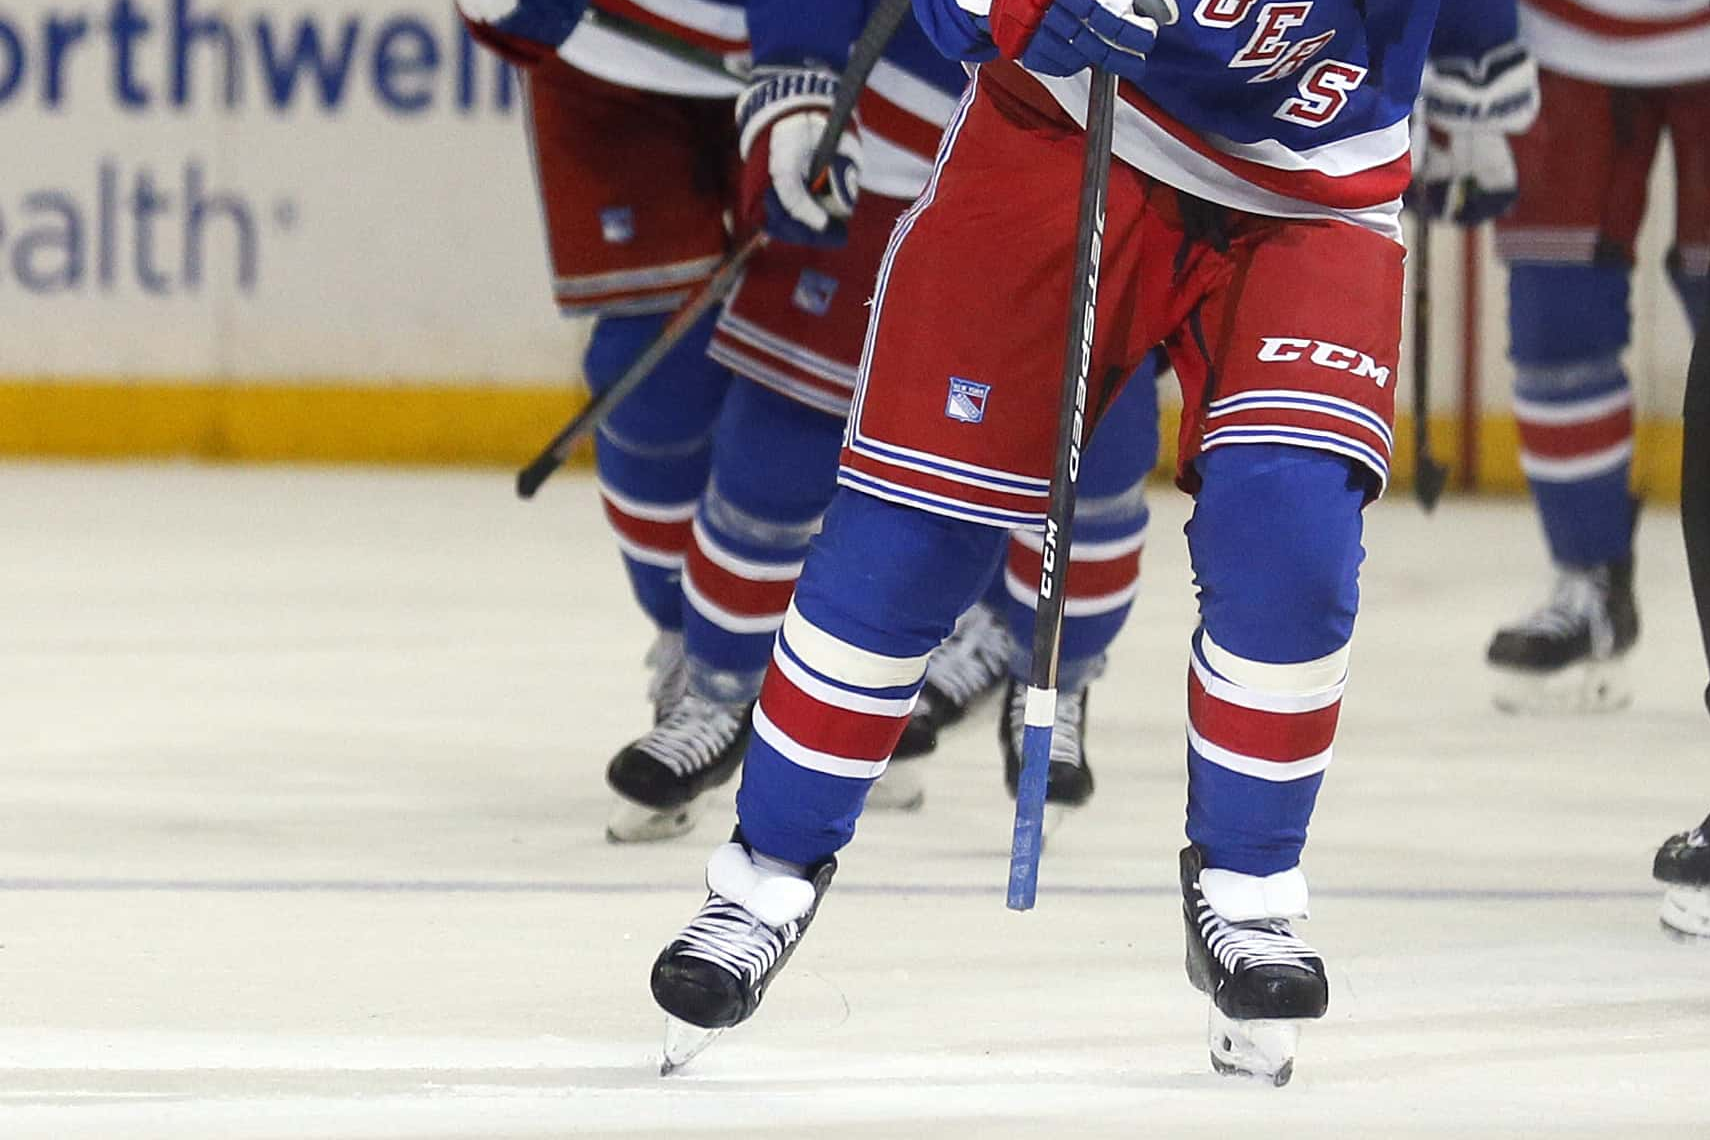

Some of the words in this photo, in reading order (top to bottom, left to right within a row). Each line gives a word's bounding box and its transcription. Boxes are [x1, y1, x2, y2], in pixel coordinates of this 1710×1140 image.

[0, 158, 260, 295] alth
[1069, 188, 1106, 483] JETSPEED
[1257, 337, 1390, 388] CCM
[1040, 519, 1060, 601] CCM
